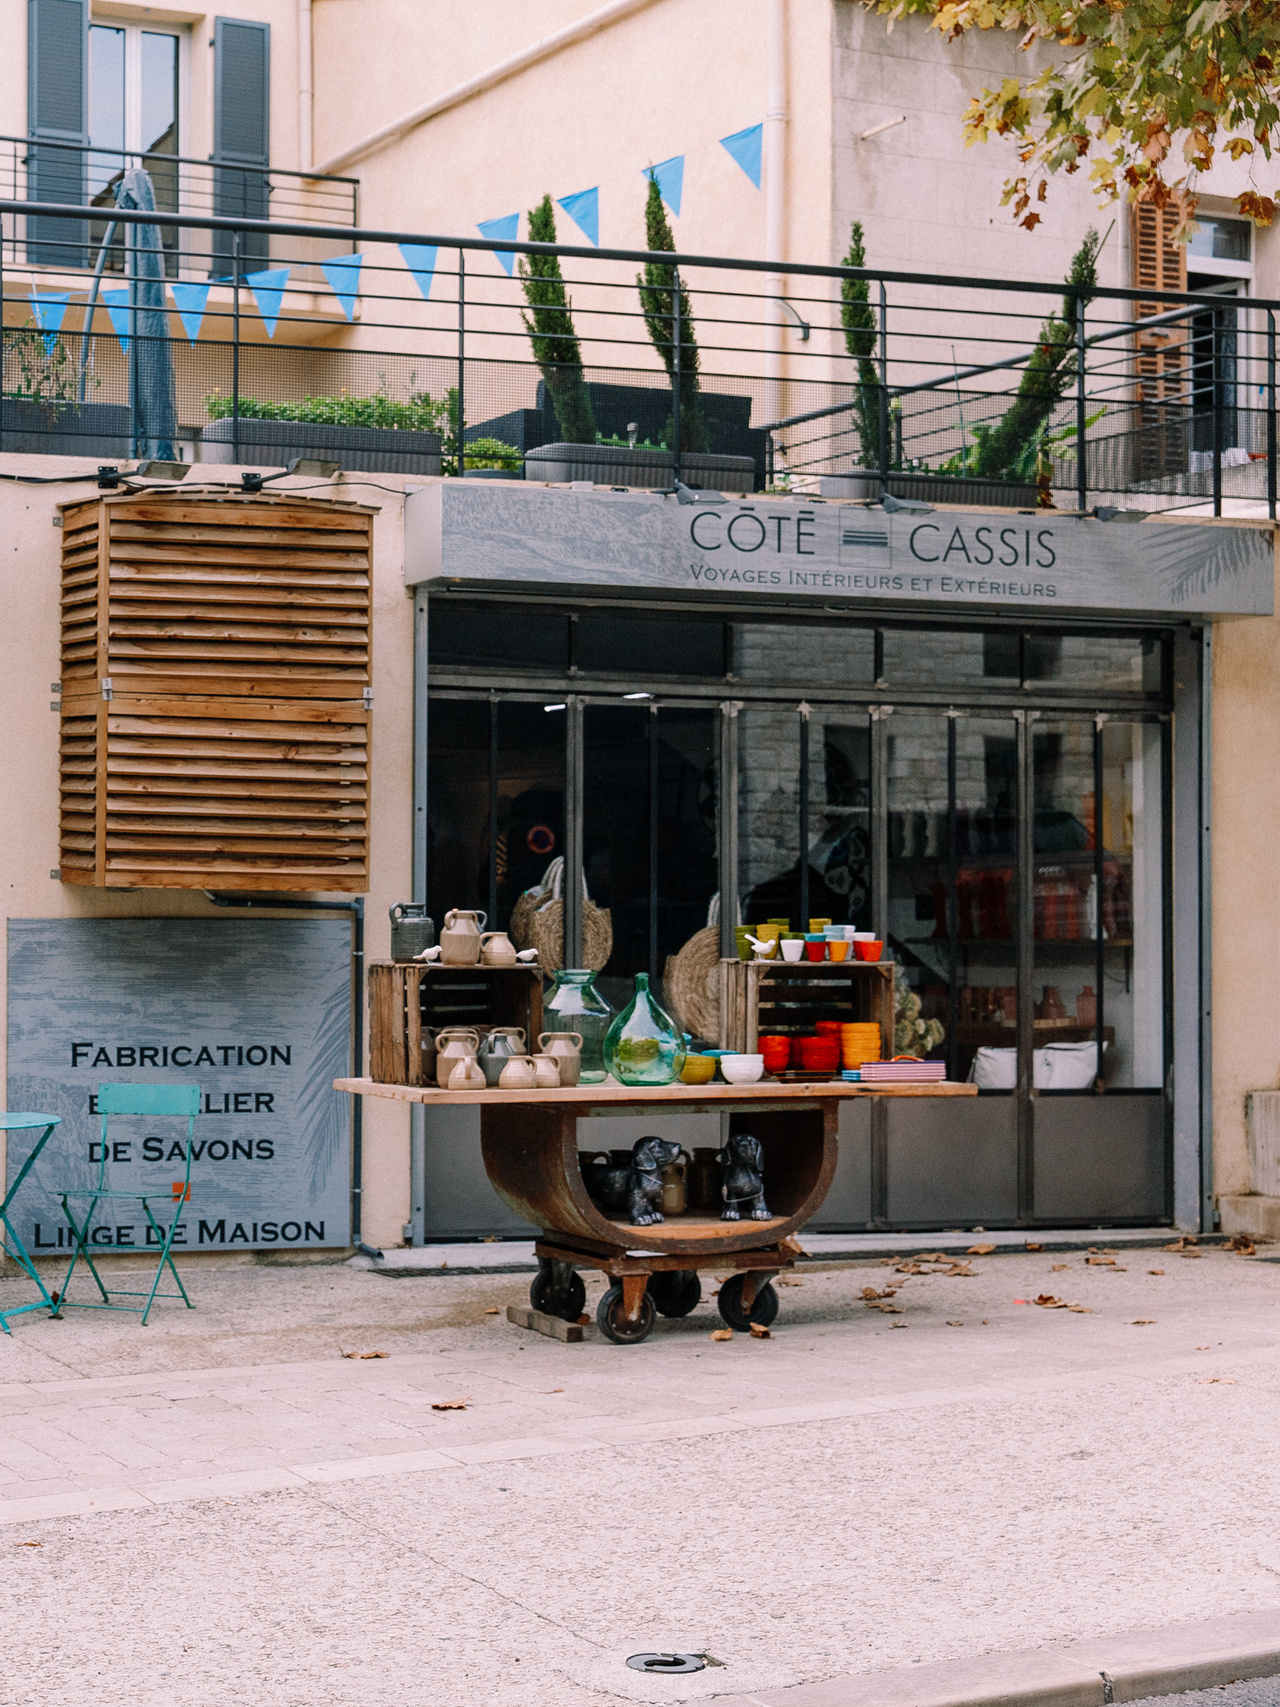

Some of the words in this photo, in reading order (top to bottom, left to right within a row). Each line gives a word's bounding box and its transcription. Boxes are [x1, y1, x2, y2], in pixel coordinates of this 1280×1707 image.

[908, 523, 1057, 568] CASSIS
[689, 563, 782, 585] VOYAGES
[788, 568, 904, 591] INTÉRIEURS
[910, 576, 933, 591] ET
[939, 575, 1057, 598] EXTÉRIEURS
[71, 1042, 292, 1068] FABRICATION
[88, 1141, 132, 1163] DE
[142, 1136, 275, 1162] SAVONS
[145, 1223, 188, 1246] DE
[198, 1219, 325, 1244] MAISON
